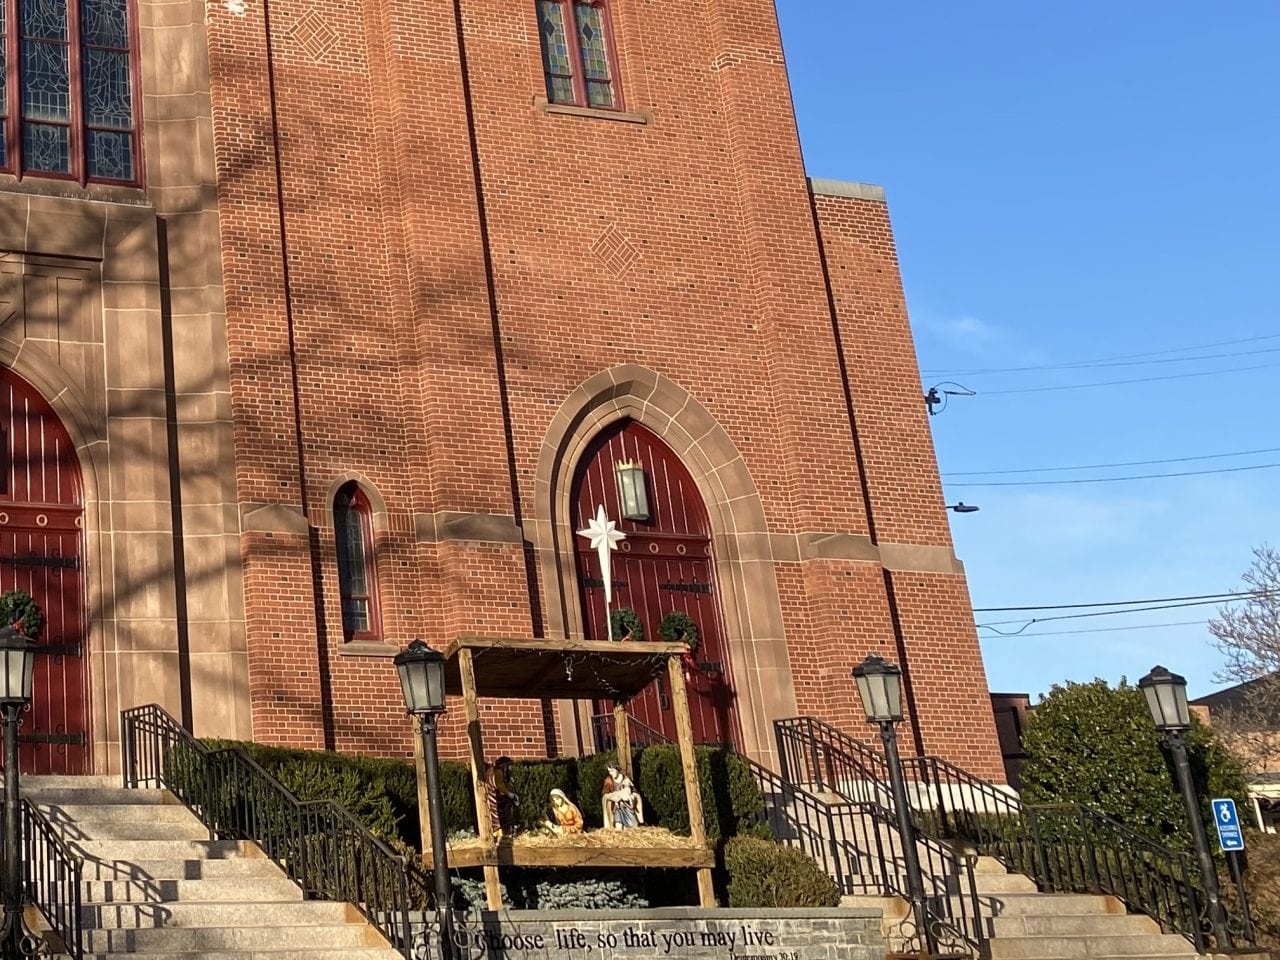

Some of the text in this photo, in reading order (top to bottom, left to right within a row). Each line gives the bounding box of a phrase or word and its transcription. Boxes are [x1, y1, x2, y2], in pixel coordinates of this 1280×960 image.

[556, 928, 593, 953] life,
[597, 932, 617, 949] so
[623, 927, 658, 948] that
[661, 931, 697, 953] you
[699, 931, 736, 952] may
[741, 924, 775, 946] live
